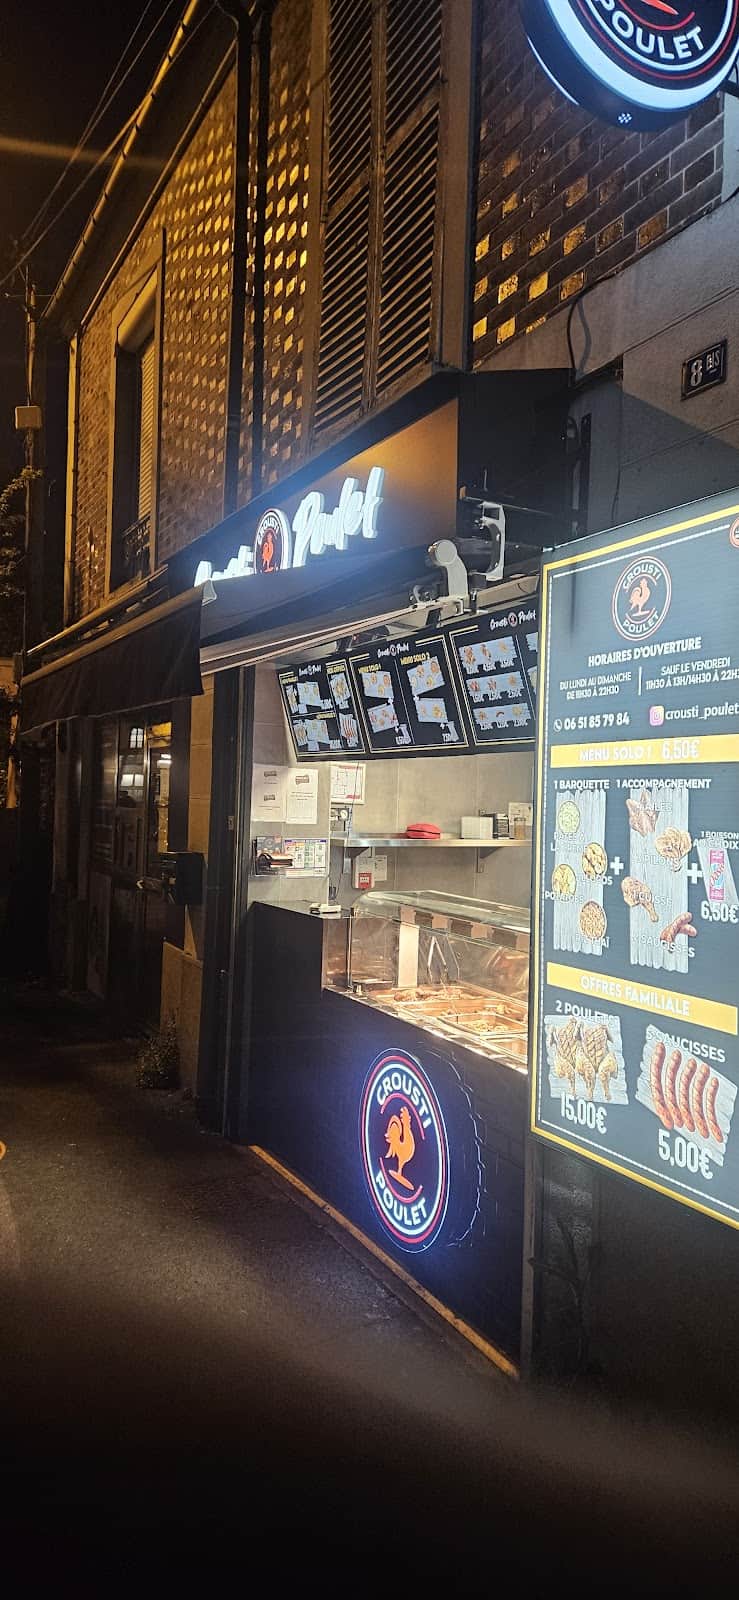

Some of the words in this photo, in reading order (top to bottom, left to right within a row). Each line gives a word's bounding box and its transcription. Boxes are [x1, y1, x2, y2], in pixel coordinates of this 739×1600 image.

[690, 359, 703, 387] 8
[623, 563, 662, 588] CROUSTI
[623, 610, 659, 633] POULET
[588, 651, 632, 667] HORAIRES
[633, 637, 702, 660] D'OUVERTURE
[661, 663, 680, 676] SAUF
[681, 662, 690, 673] LE
[691, 656, 732, 672] VENDREDI
[560, 681, 569, 690] DU
[569, 678, 587, 689] LUNDI
[588, 676, 597, 687] AU
[598, 671, 632, 686] DIMANCHE
[646, 679, 665, 691] 11H30
[666, 676, 672, 688] À
[713, 669, 720, 682] À
[567, 690, 575, 700] DE
[593, 686, 598, 697] À
[599, 685, 619, 697] 22H30
[564, 720, 576, 731] 06
[578, 718, 587, 729] 51
[589, 715, 600, 728] 85
[603, 713, 614, 727] 79
[616, 711, 630, 726] 84
[665, 702, 739, 721] crousti_poulet
[579, 744, 610, 761] MENU
[613, 744, 644, 760] SOLO
[663, 739, 700, 761] 6,50€
[553, 780, 558, 789] 1
[560, 779, 610, 791] BARQUETTE
[616, 779, 621, 788] 1
[622, 778, 712, 790] ACCOMPAGNEMENT
[705, 830, 739, 841] BOISSON
[708, 838, 739, 850] CHOIX
[701, 900, 739, 924] 6,50€
[640, 934, 695, 957] SAUCISSES
[555, 999, 563, 1013] 2
[580, 976, 622, 998] OFFRES
[625, 987, 691, 1016] FAMILIALE
[655, 1030, 726, 1063] SAUCISSES
[376, 1072, 432, 1129] CROUSTI
[560, 1092, 607, 1135] 15,00€
[658, 1128, 713, 1180] 5,00€
[374, 1170, 428, 1226] POULET
